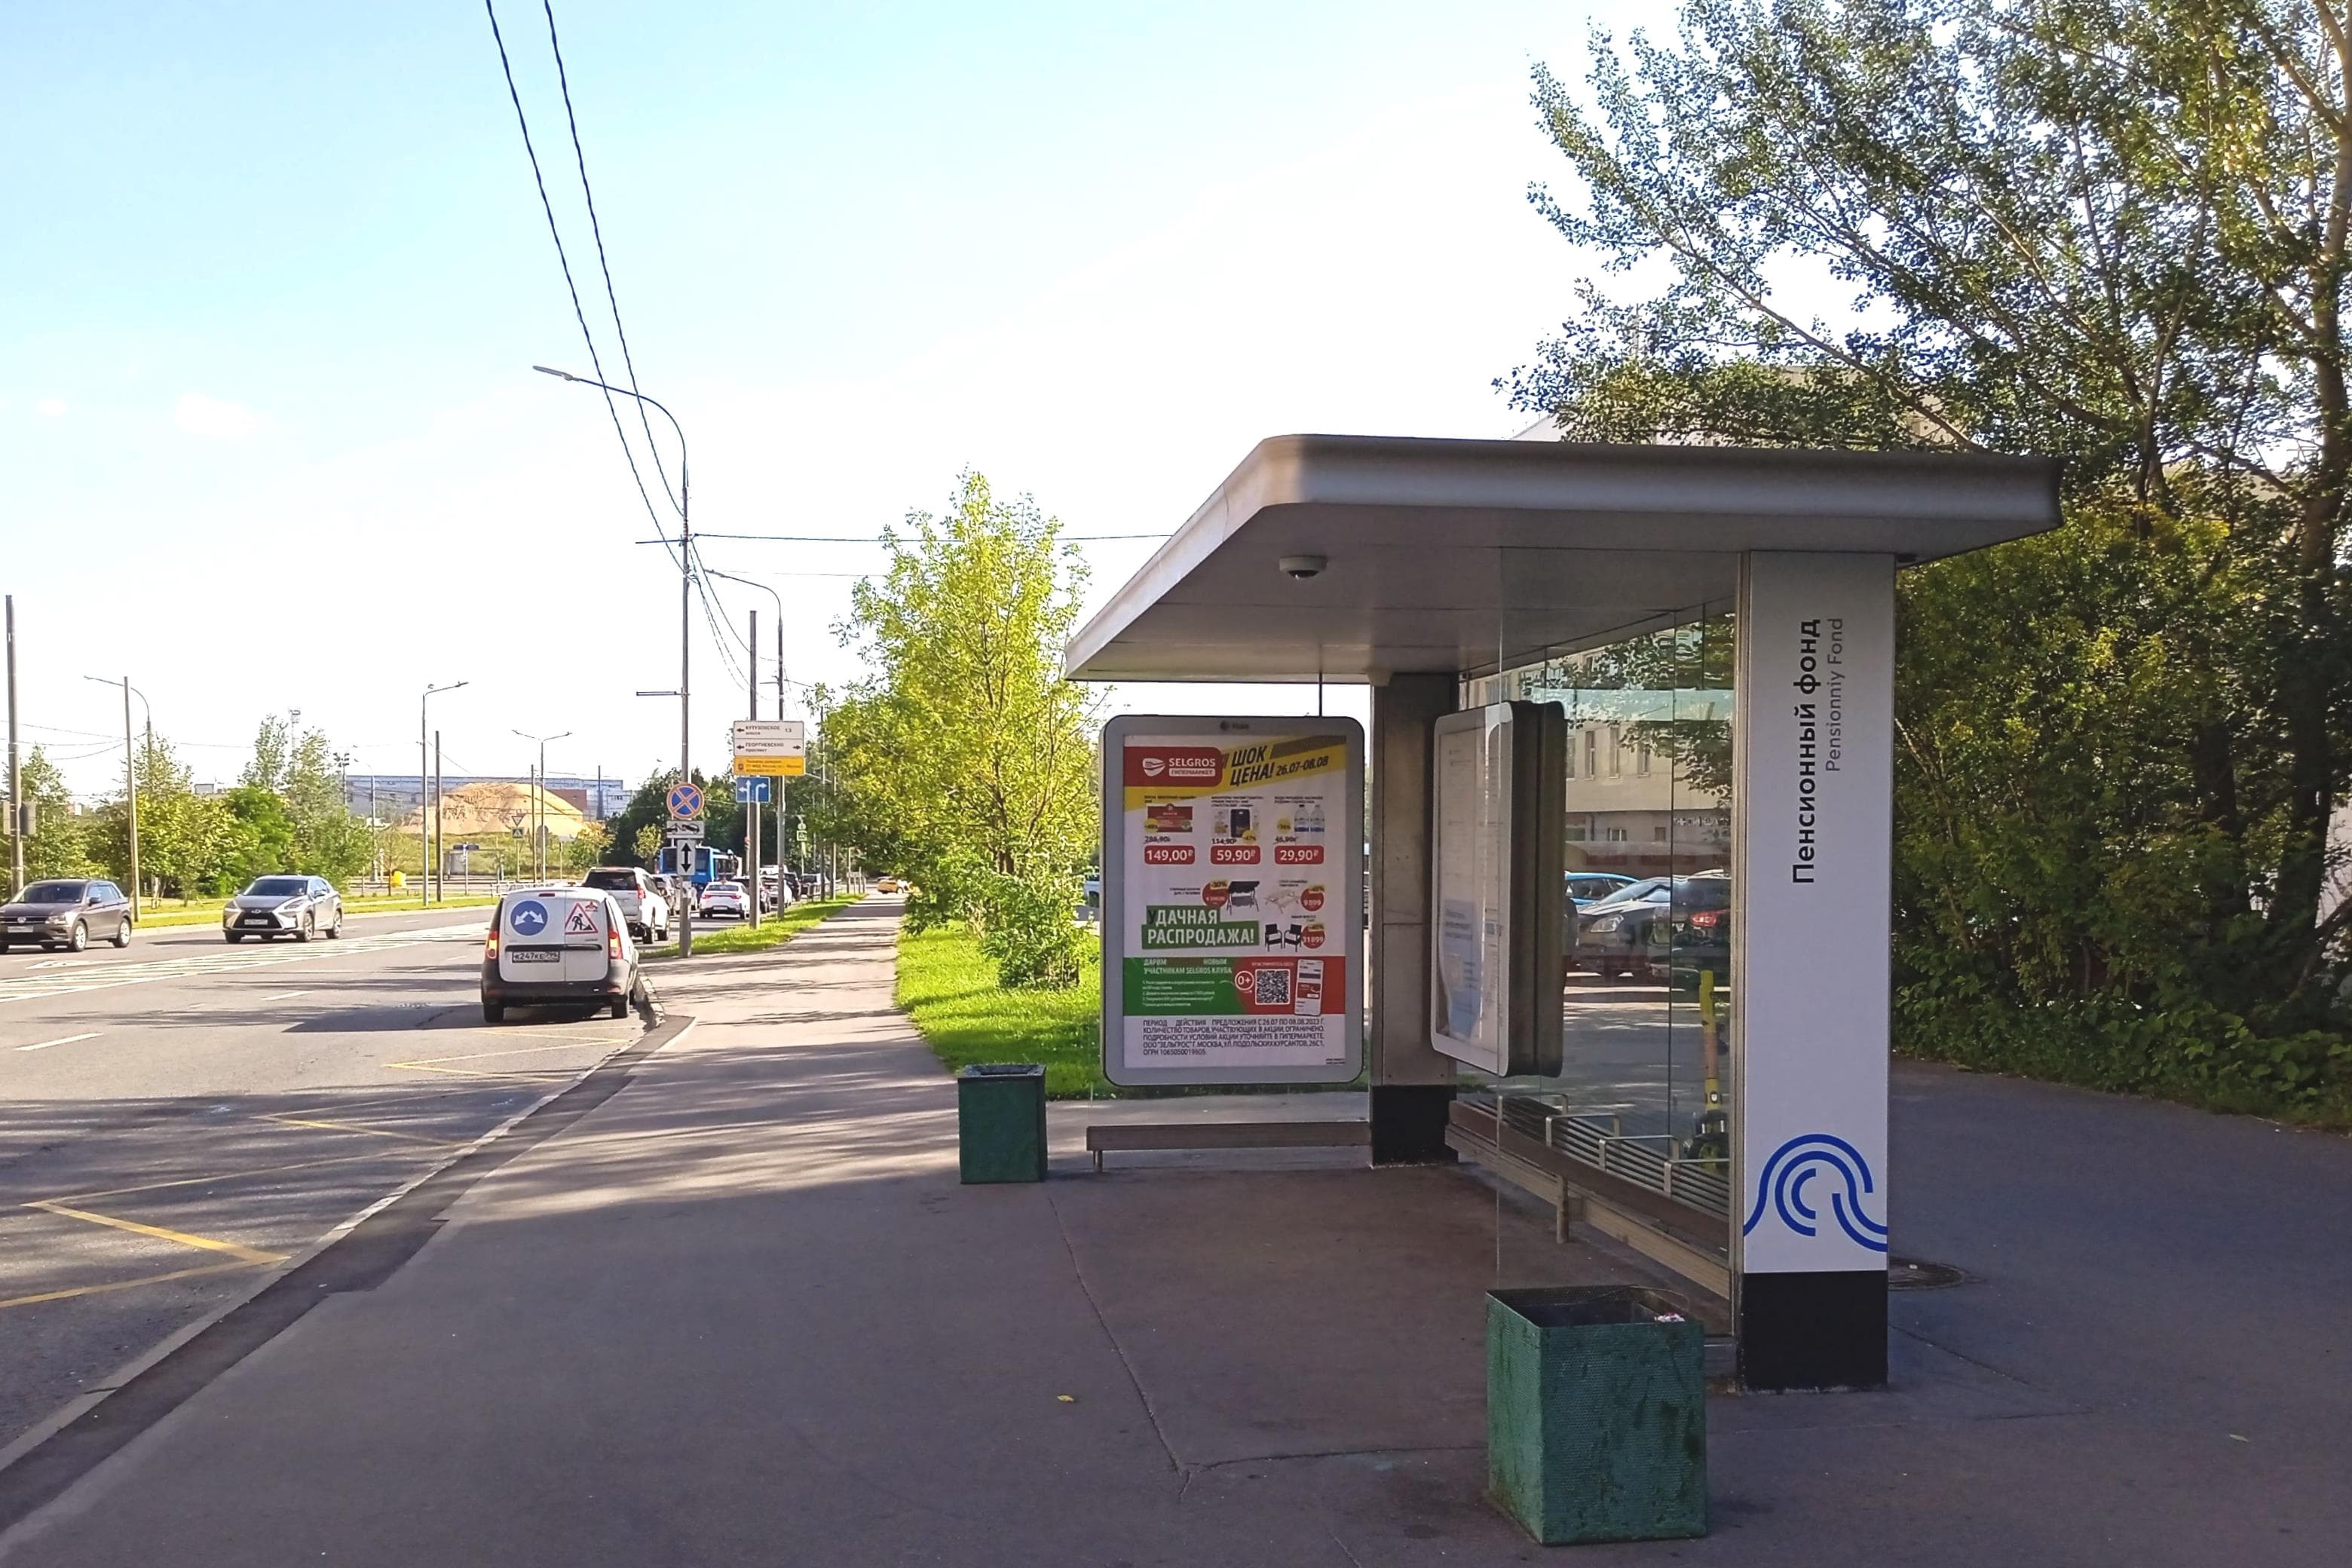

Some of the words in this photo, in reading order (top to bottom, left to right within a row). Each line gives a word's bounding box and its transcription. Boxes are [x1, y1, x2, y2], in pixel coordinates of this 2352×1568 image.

[1827, 618, 1843, 665] Fond
[1793, 619, 1821, 695] фонд
[1825, 671, 1845, 772] Pensionniy
[1168, 758, 1216, 767] SELGROS
[1231, 745, 1268, 767] ШОК
[1230, 762, 1276, 787] ЦЕНА!
[1793, 703, 1815, 884] Пенсионный
[1147, 928, 1254, 946] РАСПРОДАЖА!
[1237, 975, 1251, 985] 0+
